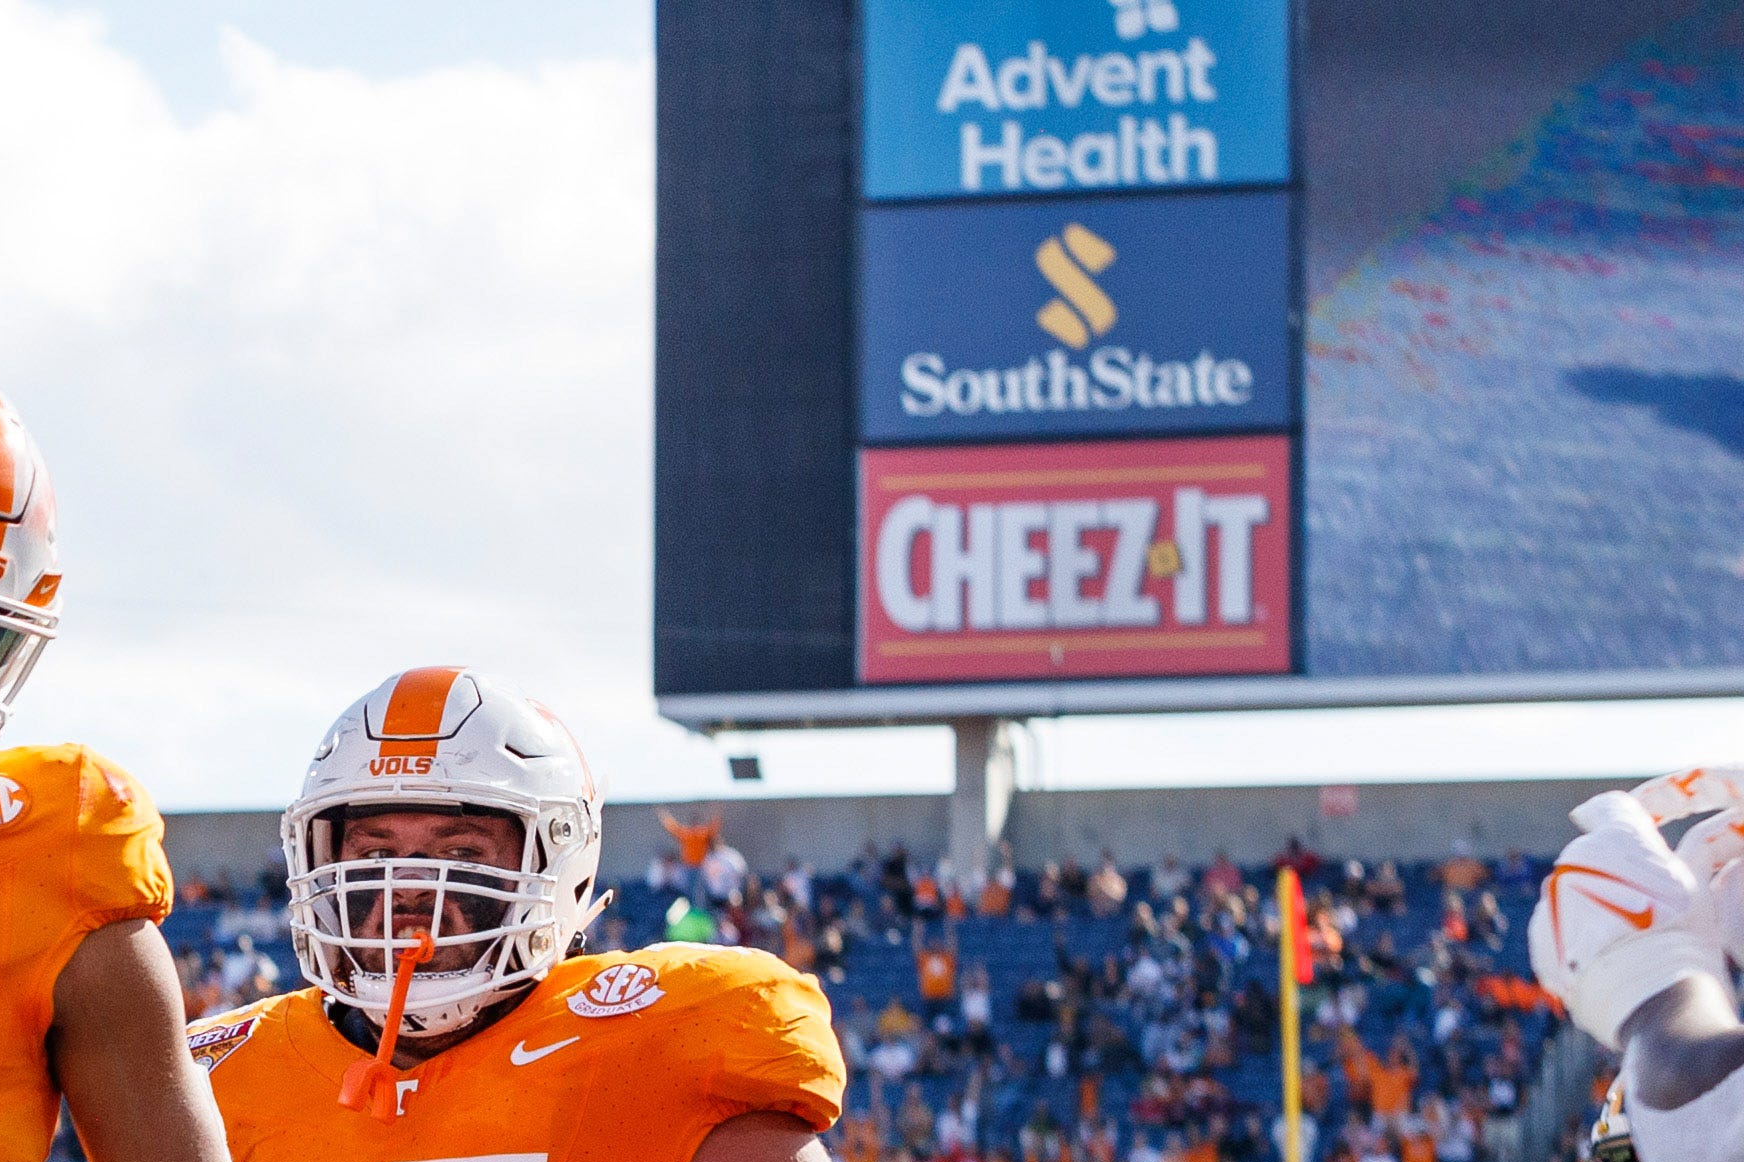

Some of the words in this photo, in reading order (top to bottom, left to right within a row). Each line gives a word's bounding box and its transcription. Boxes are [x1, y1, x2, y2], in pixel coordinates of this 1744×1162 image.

[938, 38, 1217, 113] Advent
[958, 114, 1218, 191] Health
[900, 346, 1253, 417] SouthState
[369, 757, 433, 777] VOLS
[573, 998, 645, 1016] GRADUATE
[590, 963, 653, 1004] SEC
